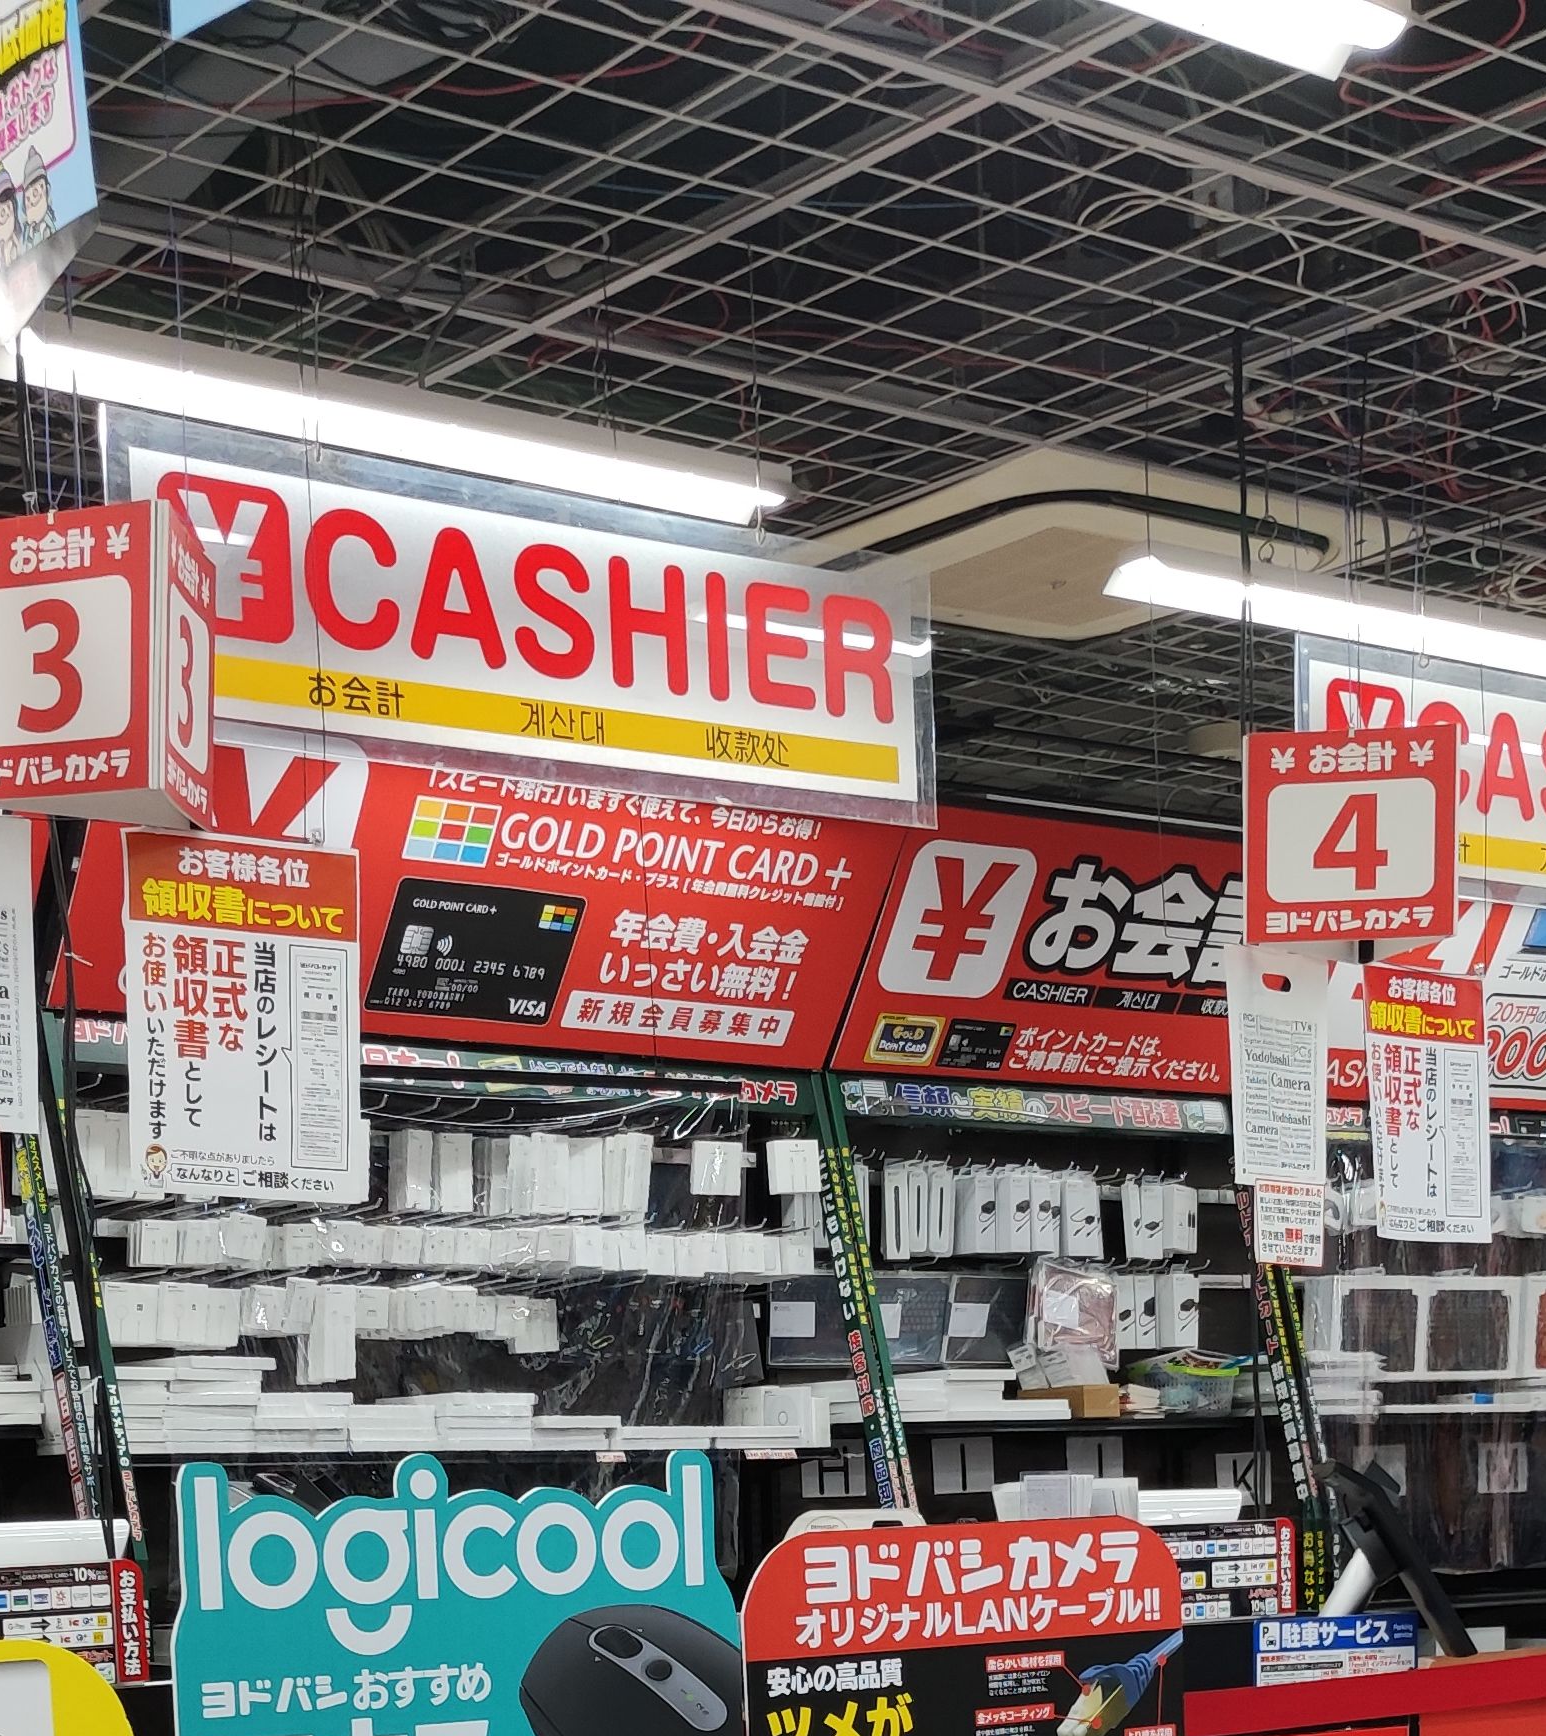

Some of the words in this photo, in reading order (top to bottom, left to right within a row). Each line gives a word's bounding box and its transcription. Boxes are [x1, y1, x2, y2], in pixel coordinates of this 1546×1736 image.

[9, 527, 95, 576] お会計
[303, 507, 895, 725] CASHIER
[16, 597, 82, 733] 3
[177, 614, 193, 748] 3
[309, 673, 404, 719] お会計
[520, 700, 605, 746] 계산대
[705, 726, 788, 769] 收款处
[1308, 740, 1397, 772] お会計
[178, 846, 310, 888] お客様各位
[501, 812, 605, 860] GOLD
[612, 828, 725, 875] POINT
[728, 845, 819, 886] CARD
[1313, 793, 1389, 891] 4
[141, 877, 345, 934] 領収書について
[1265, 906, 1435, 934] ヨドバシカメラ
[609, 908, 810, 966] 年会費・入会金
[213, 938, 249, 1053] 正式な
[599, 951, 795, 1002] いっさい無料!
[1012, 981, 1088, 1005] CASHIER
[1388, 977, 1457, 1007] お客様各位
[172, 934, 211, 1129] 領収書として
[508, 997, 546, 1019] VISA
[577, 996, 782, 1040] 新規会員募集中
[1369, 1003, 1476, 1039] 領収書について
[141, 932, 168, 1140] お使いいただけます
[253, 941, 277, 1143] 当店のレシートは
[1018, 1026, 1162, 1058] ポイントカードは、
[1245, 1048, 1291, 1068] Yodobashi
[1007, 1049, 1222, 1085] ご精算前にご提示ください。
[1270, 1071, 1311, 1092] Camera
[1403, 1045, 1421, 1131] 正式な
[1384, 1043, 1403, 1190] 領収書として
[1424, 1046, 1439, 1199] 当店のレシートは
[175, 1167, 237, 1184] なんなりと
[242, 1170, 335, 1192] ご相談ください
[194, 1464, 705, 1655] logicool
[803, 1530, 1141, 1605] ヨドバシカメラ
[118, 1570, 142, 1676] お支払い方法
[795, 1588, 1163, 1650] オリジナルLANケーブル!!
[1281, 1619, 1390, 1649] 駐車サービス
[201, 1662, 491, 1719] ヨドバシおすすめ
[766, 1657, 904, 1699] 安心の高品質
